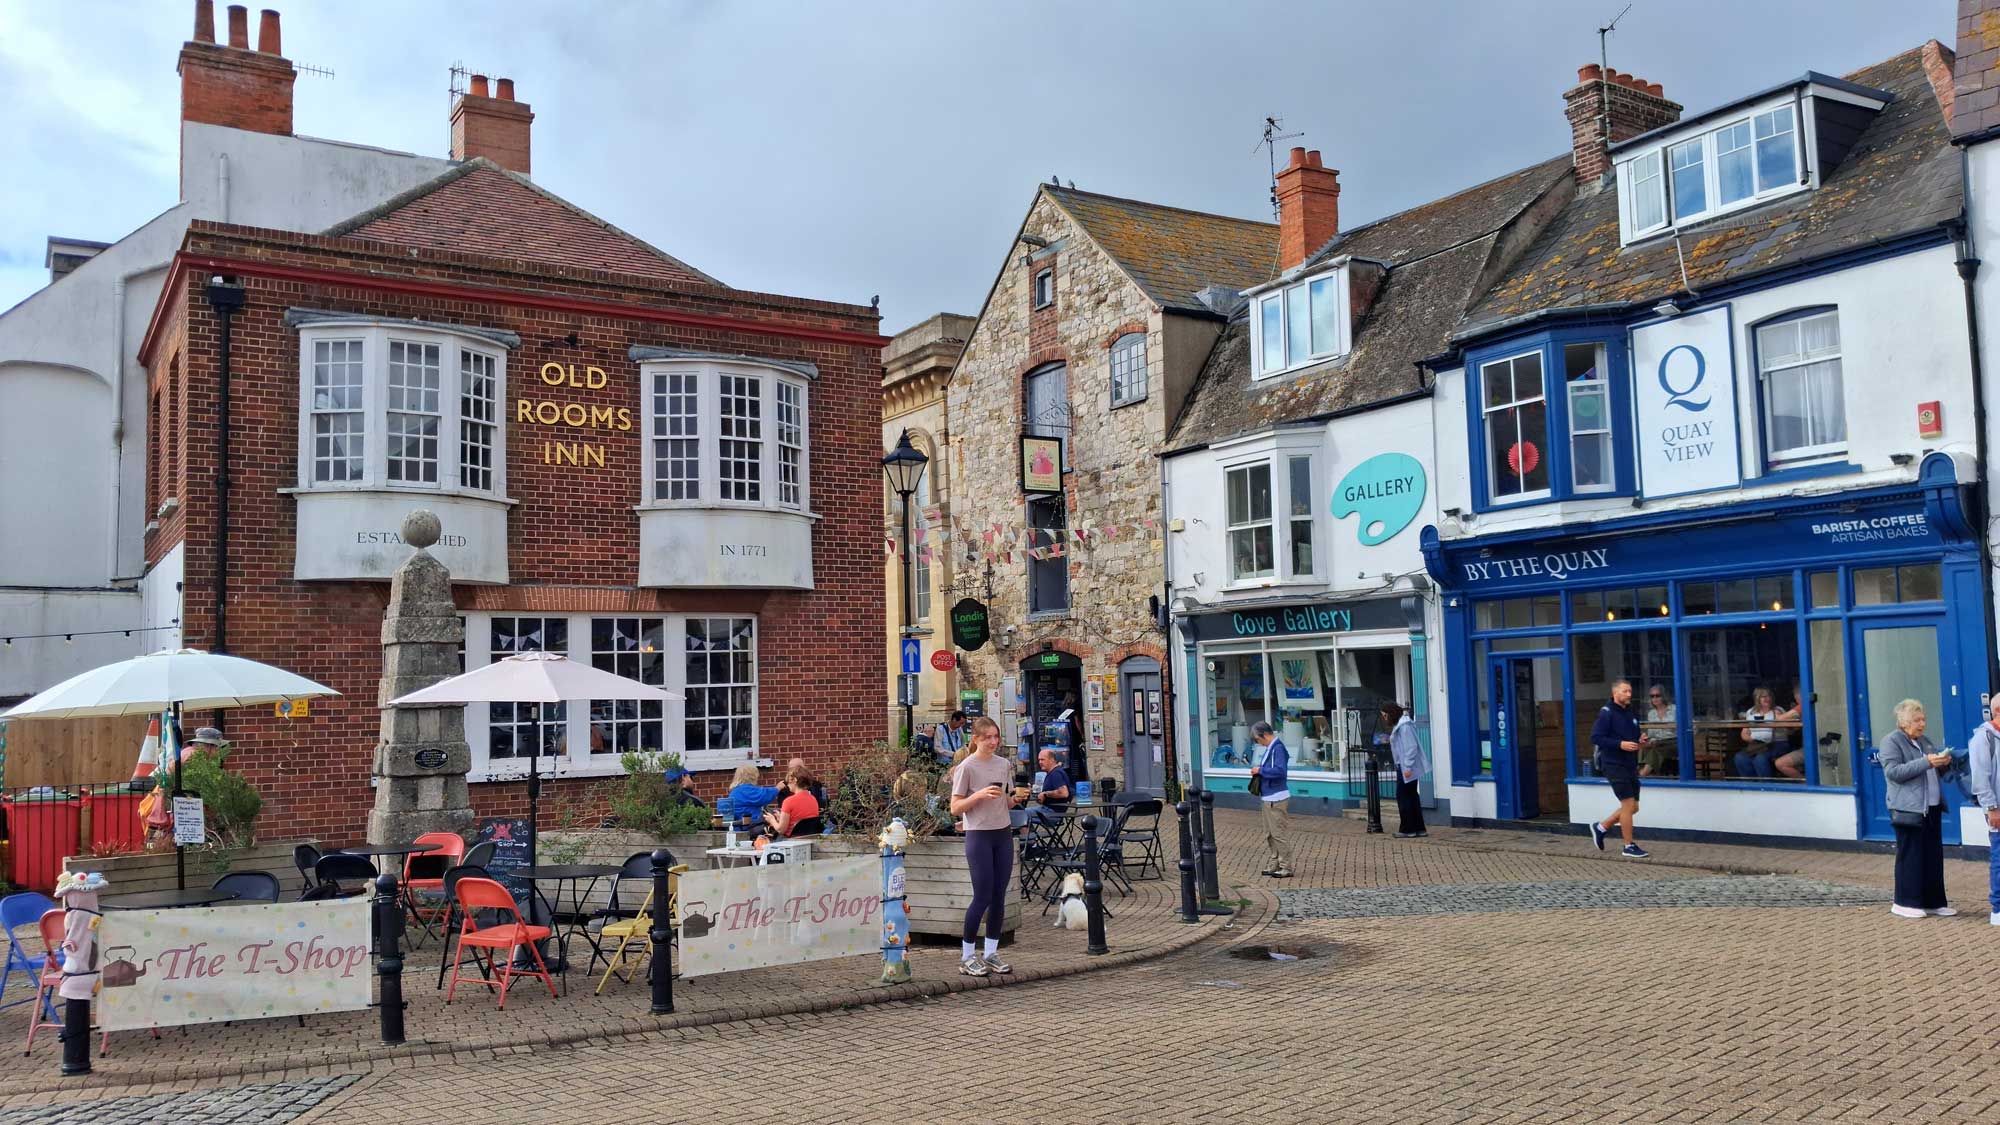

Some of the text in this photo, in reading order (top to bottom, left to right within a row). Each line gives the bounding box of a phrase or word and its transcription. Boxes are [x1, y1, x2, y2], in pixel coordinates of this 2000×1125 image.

[541, 362, 607, 389] OLD
[1658, 345, 1712, 412] Q
[517, 399, 632, 431] ROOMS
[1661, 421, 1712, 447] QUAY
[544, 441, 605, 467] INN
[1663, 442, 1714, 463] VIEW
[1344, 476, 1414, 502] GALLERY
[1812, 514, 1926, 534] BARISTA COFFEE
[1831, 525, 1929, 544] ARTISAN BAKES
[357, 531, 467, 547] ESTAHED
[720, 544, 766, 557] IN 1771
[1464, 549, 1609, 581] BY THE QUAY
[954, 611, 985, 623] Londis
[1233, 606, 1351, 635] Cove Gallery
[723, 888, 880, 931] The T-Shop
[157, 934, 368, 981] The T-Shop
